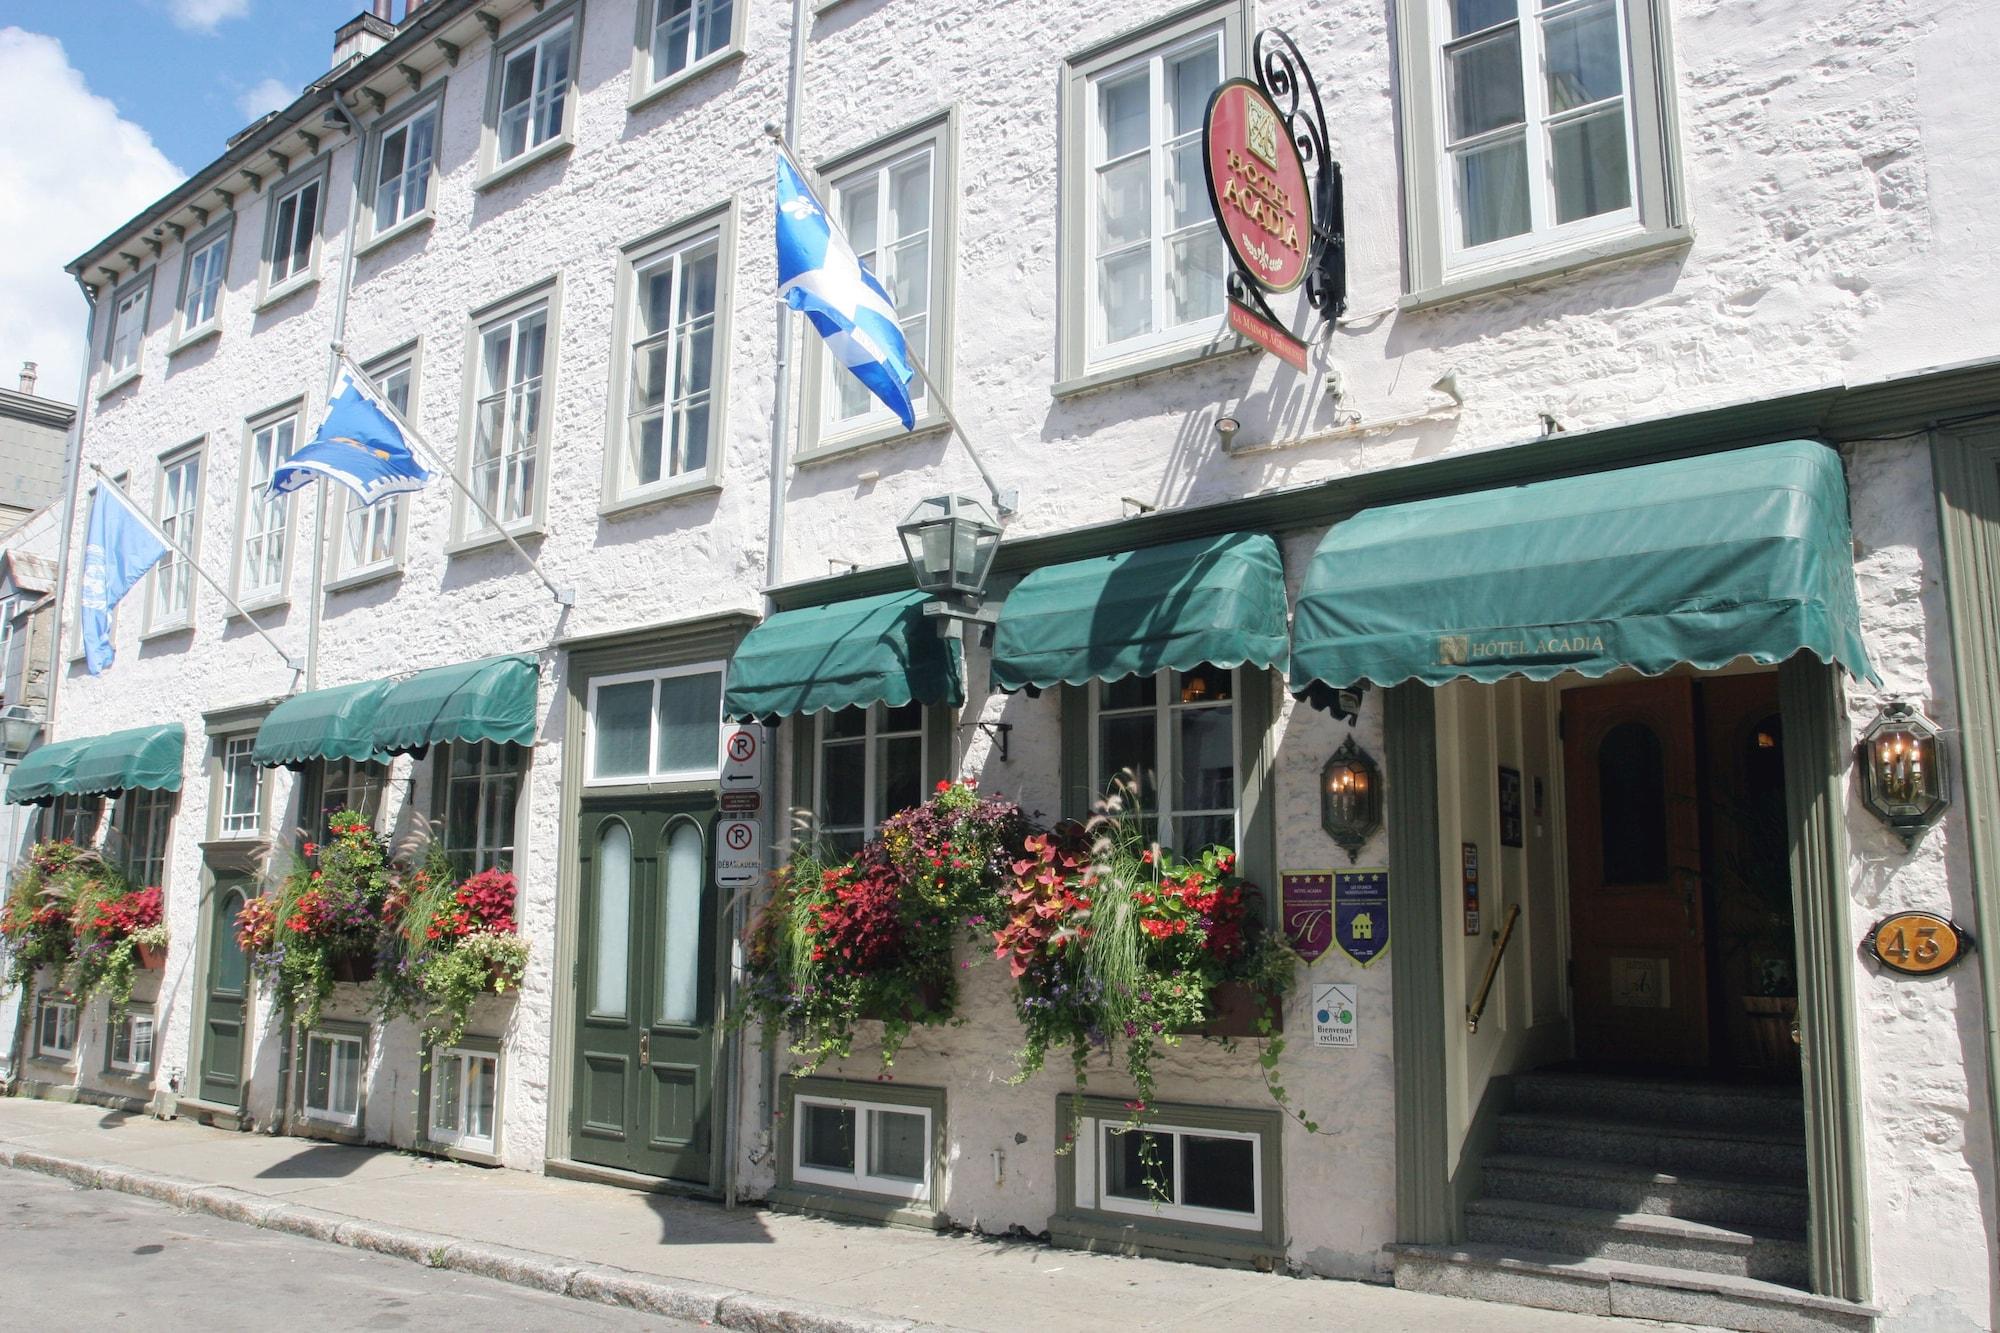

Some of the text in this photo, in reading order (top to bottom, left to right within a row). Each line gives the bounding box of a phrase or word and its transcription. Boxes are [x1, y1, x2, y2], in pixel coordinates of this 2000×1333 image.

[1223, 177, 1301, 253] ACADIA
[1242, 314, 1269, 341] MAISON
[1472, 635, 1604, 657] HÔTEL ACADIA
[1884, 926, 1941, 965] 43
[1317, 1024, 1353, 1034] Bienvenue
[1320, 1033, 1351, 1044] cyclistes!
